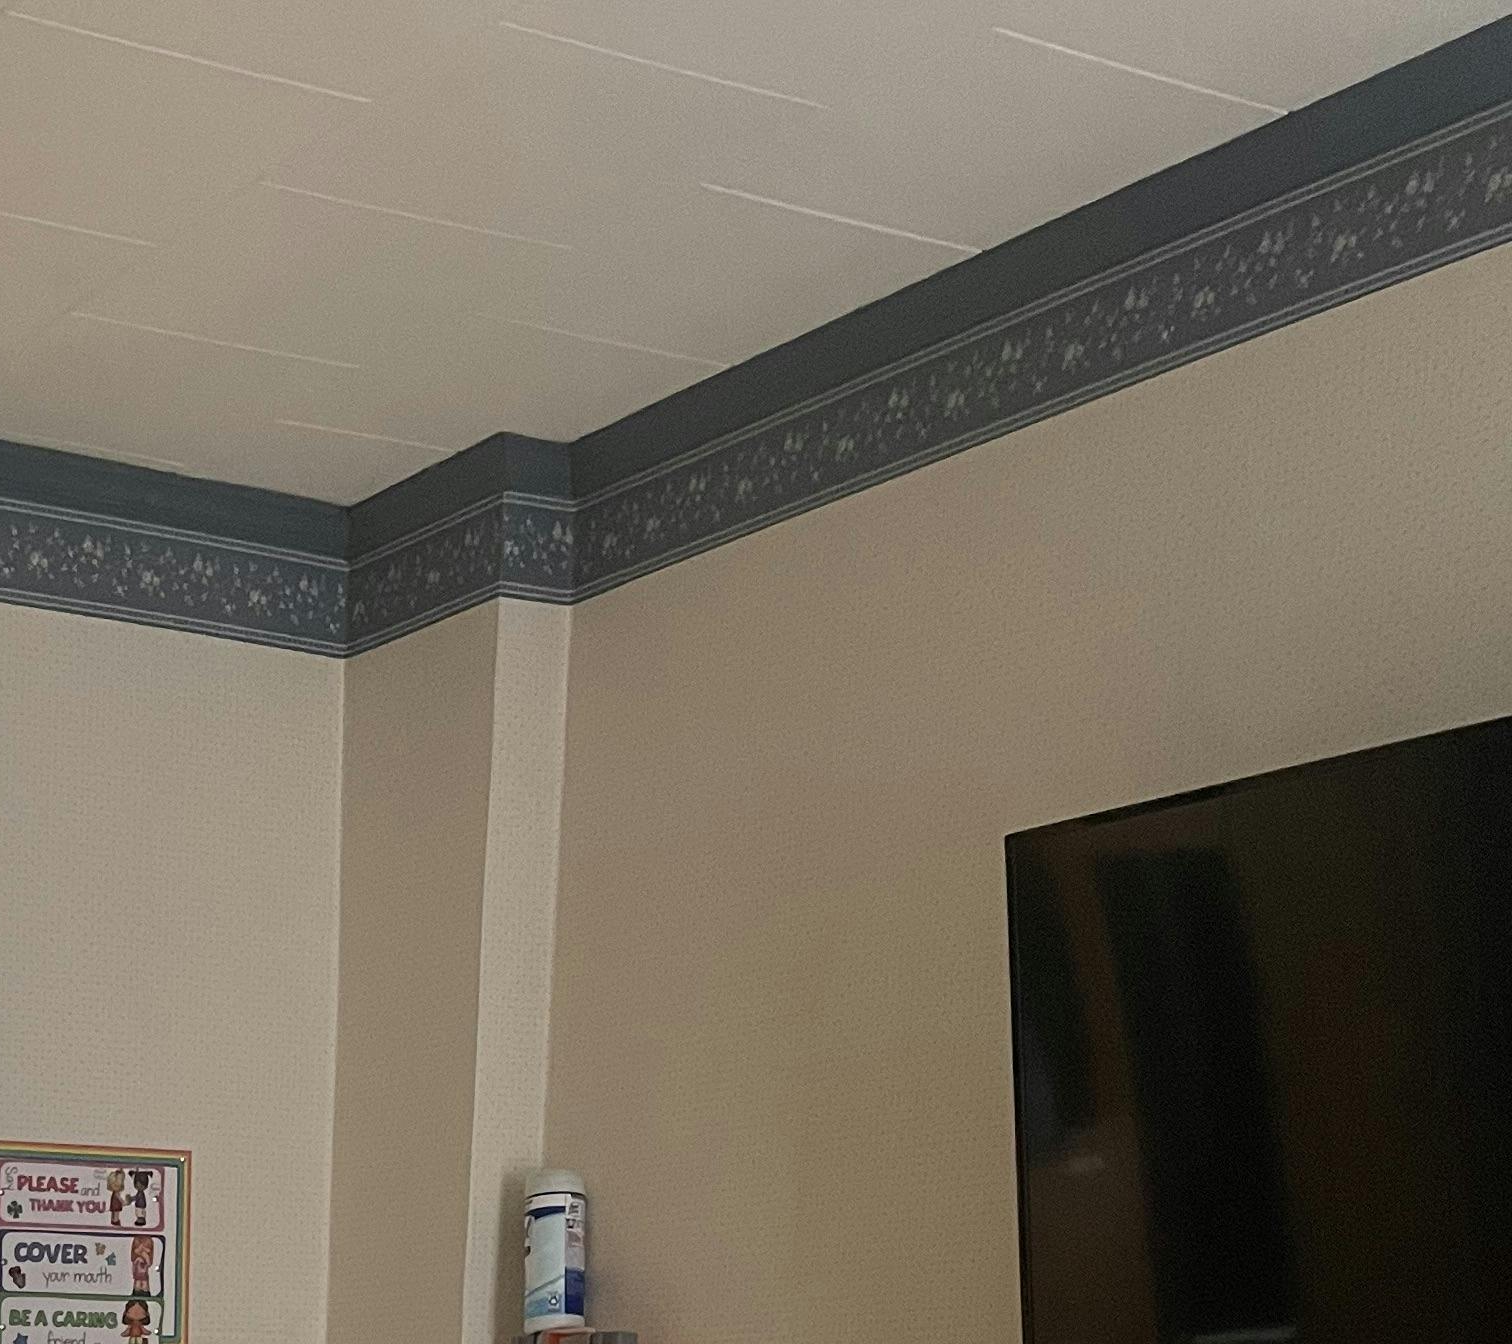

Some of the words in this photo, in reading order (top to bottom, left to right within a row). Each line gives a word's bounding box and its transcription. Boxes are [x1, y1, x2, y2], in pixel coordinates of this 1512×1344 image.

[5, 1166, 18, 1191] Say
[17, 1175, 79, 1193] PLEASE
[81, 1183, 100, 1196] and
[29, 1198, 74, 1212] THANK
[78, 1201, 106, 1213] YOU
[14, 1241, 88, 1264] COVER
[42, 1271, 70, 1287] your
[73, 1267, 112, 1283] mouth
[8, 1309, 32, 1327] BE
[34, 1310, 48, 1327] A
[52, 1310, 119, 1329] CARING
